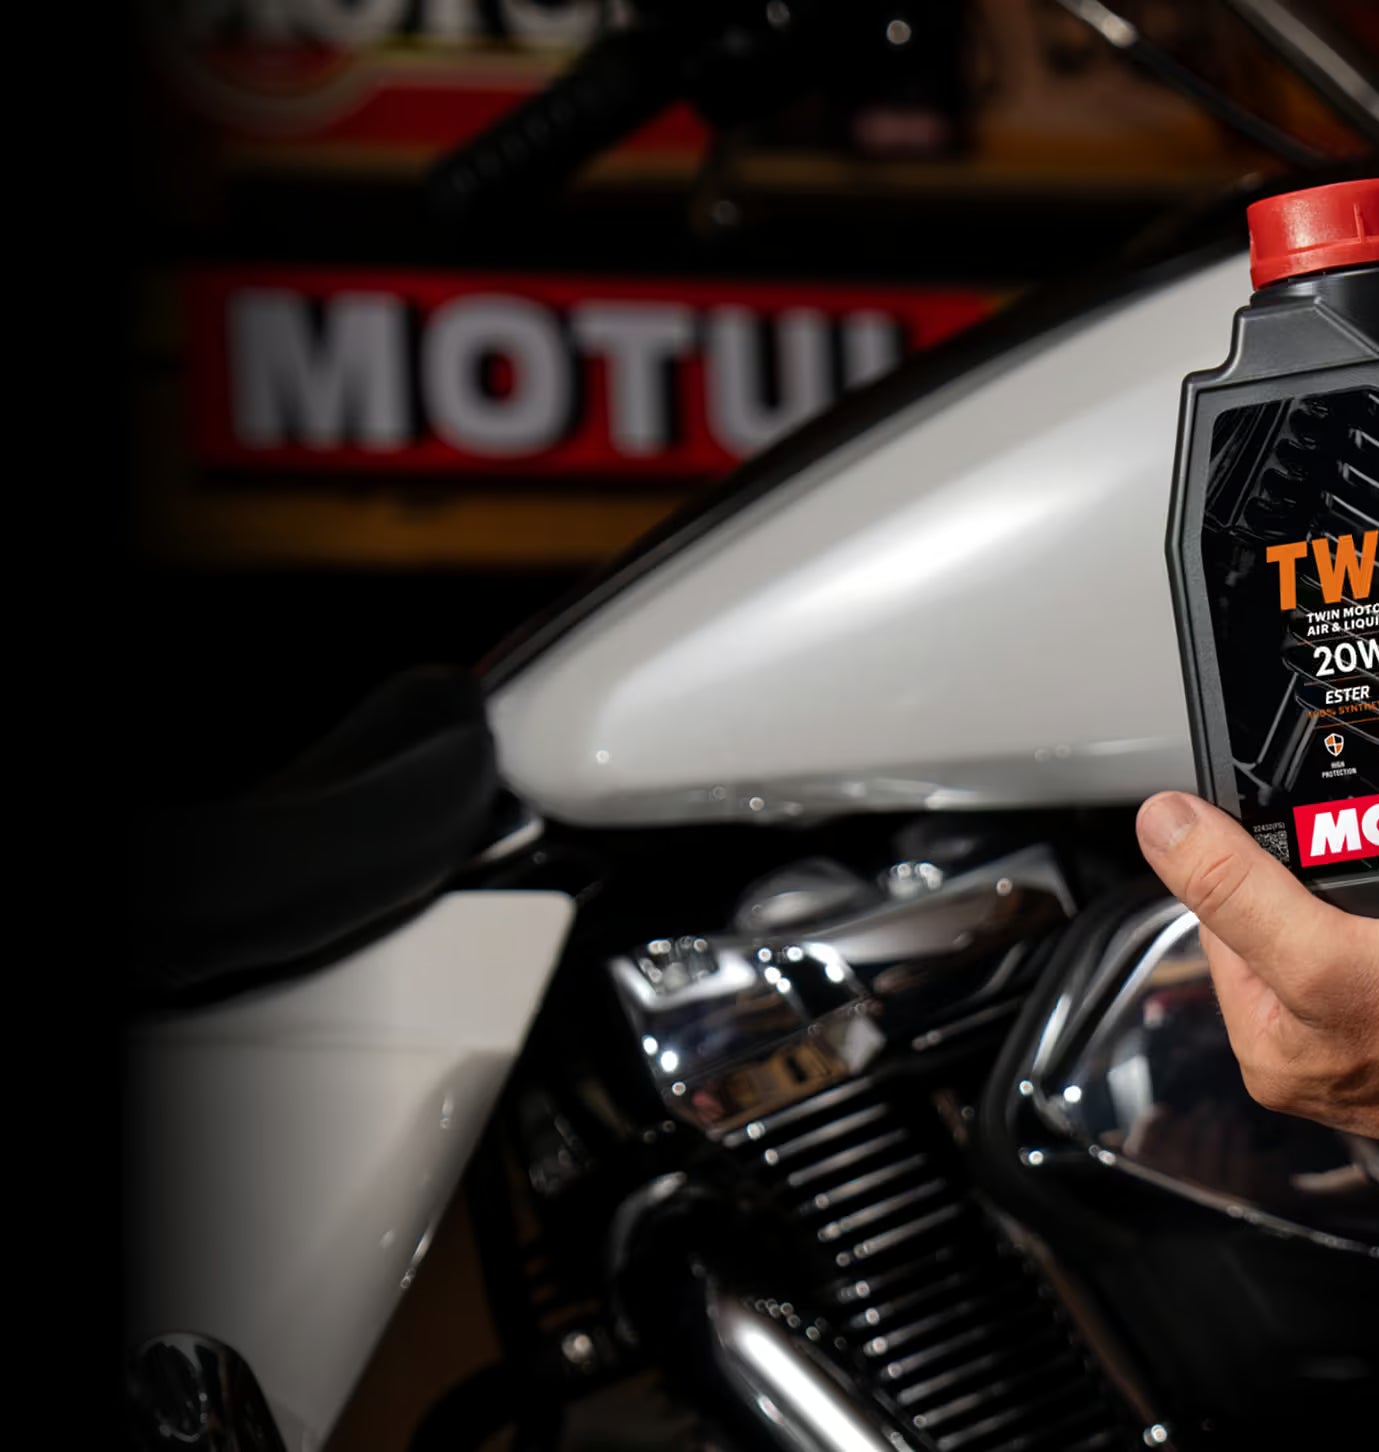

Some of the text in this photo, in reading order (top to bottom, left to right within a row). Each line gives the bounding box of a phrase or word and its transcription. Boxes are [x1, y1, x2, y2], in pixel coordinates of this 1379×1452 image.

[1306, 609, 1340, 624] TWIN
[1307, 624, 1329, 636] AIR
[1331, 622, 1341, 633] &
[1325, 685, 1370, 704] ESTER
[1331, 761, 1345, 769] HIGH
[1322, 768, 1357, 779] PROTECTION
